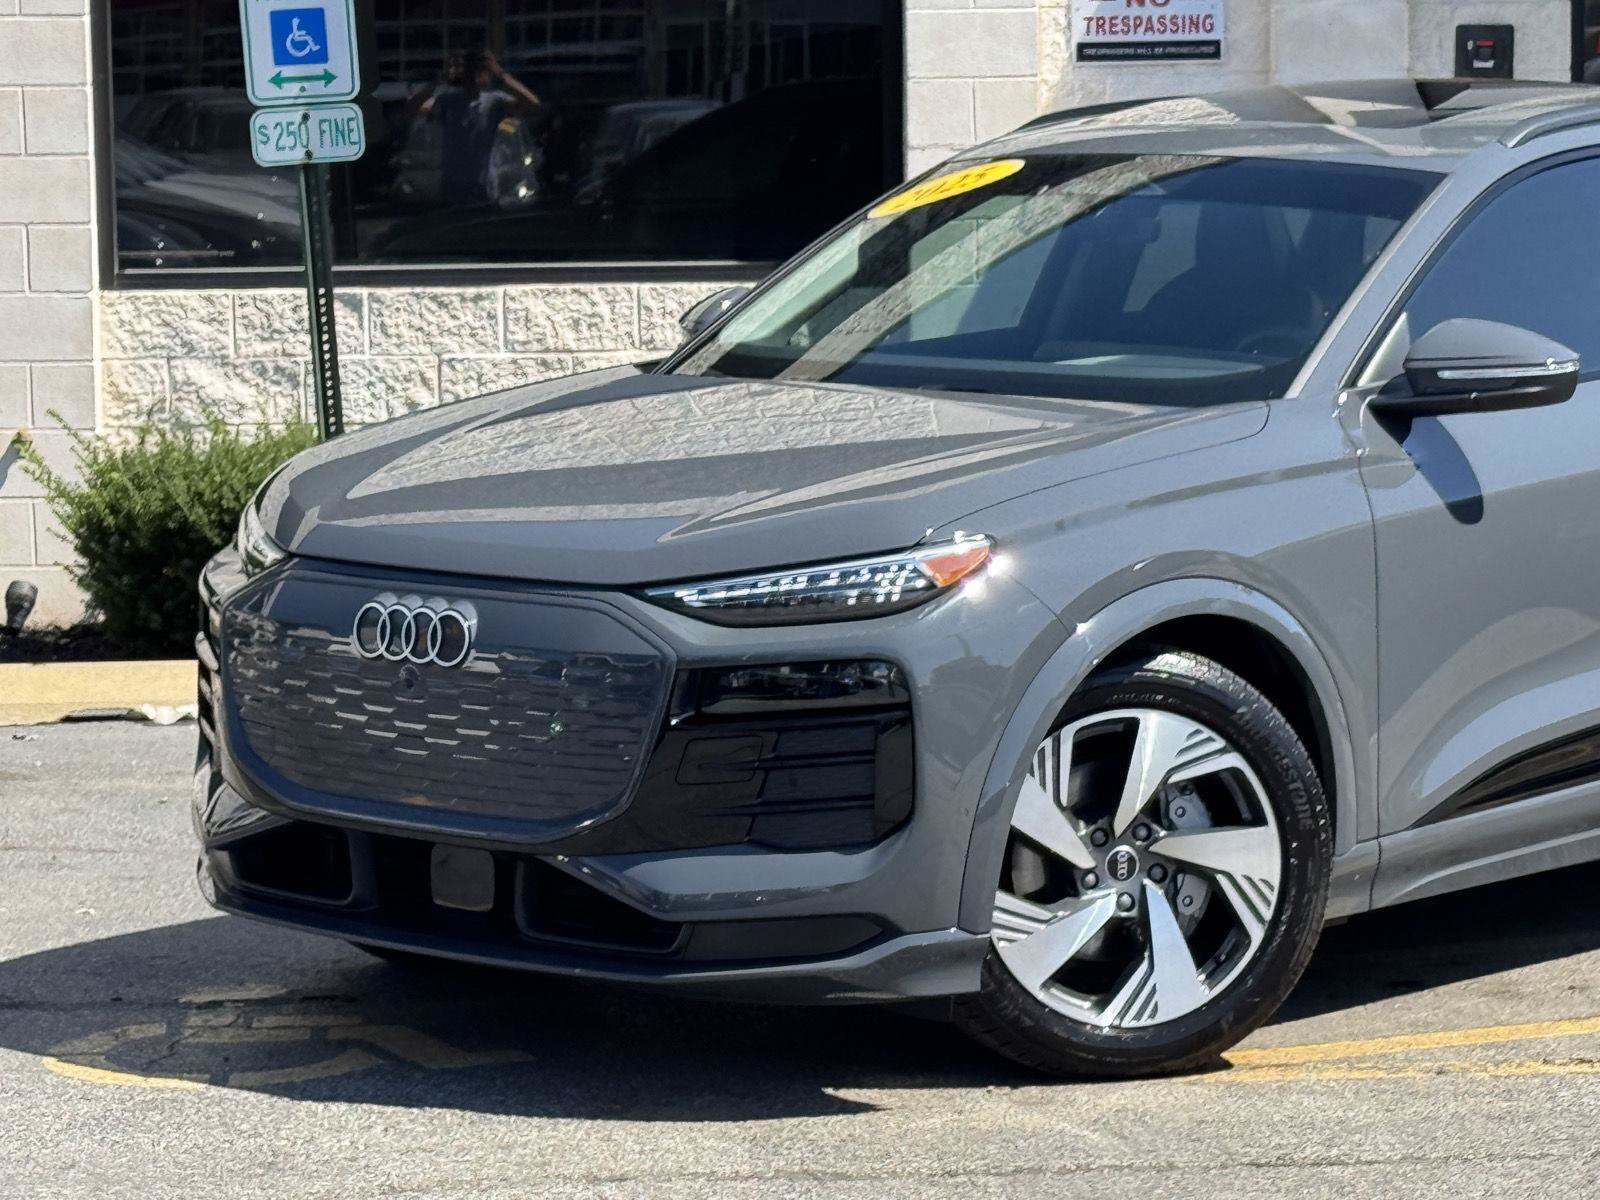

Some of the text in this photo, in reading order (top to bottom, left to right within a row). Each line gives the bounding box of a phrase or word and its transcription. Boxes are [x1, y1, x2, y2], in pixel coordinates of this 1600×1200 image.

[1083, 14, 1215, 36] TRESPASSING
[257, 116, 360, 151] $250 FINE
